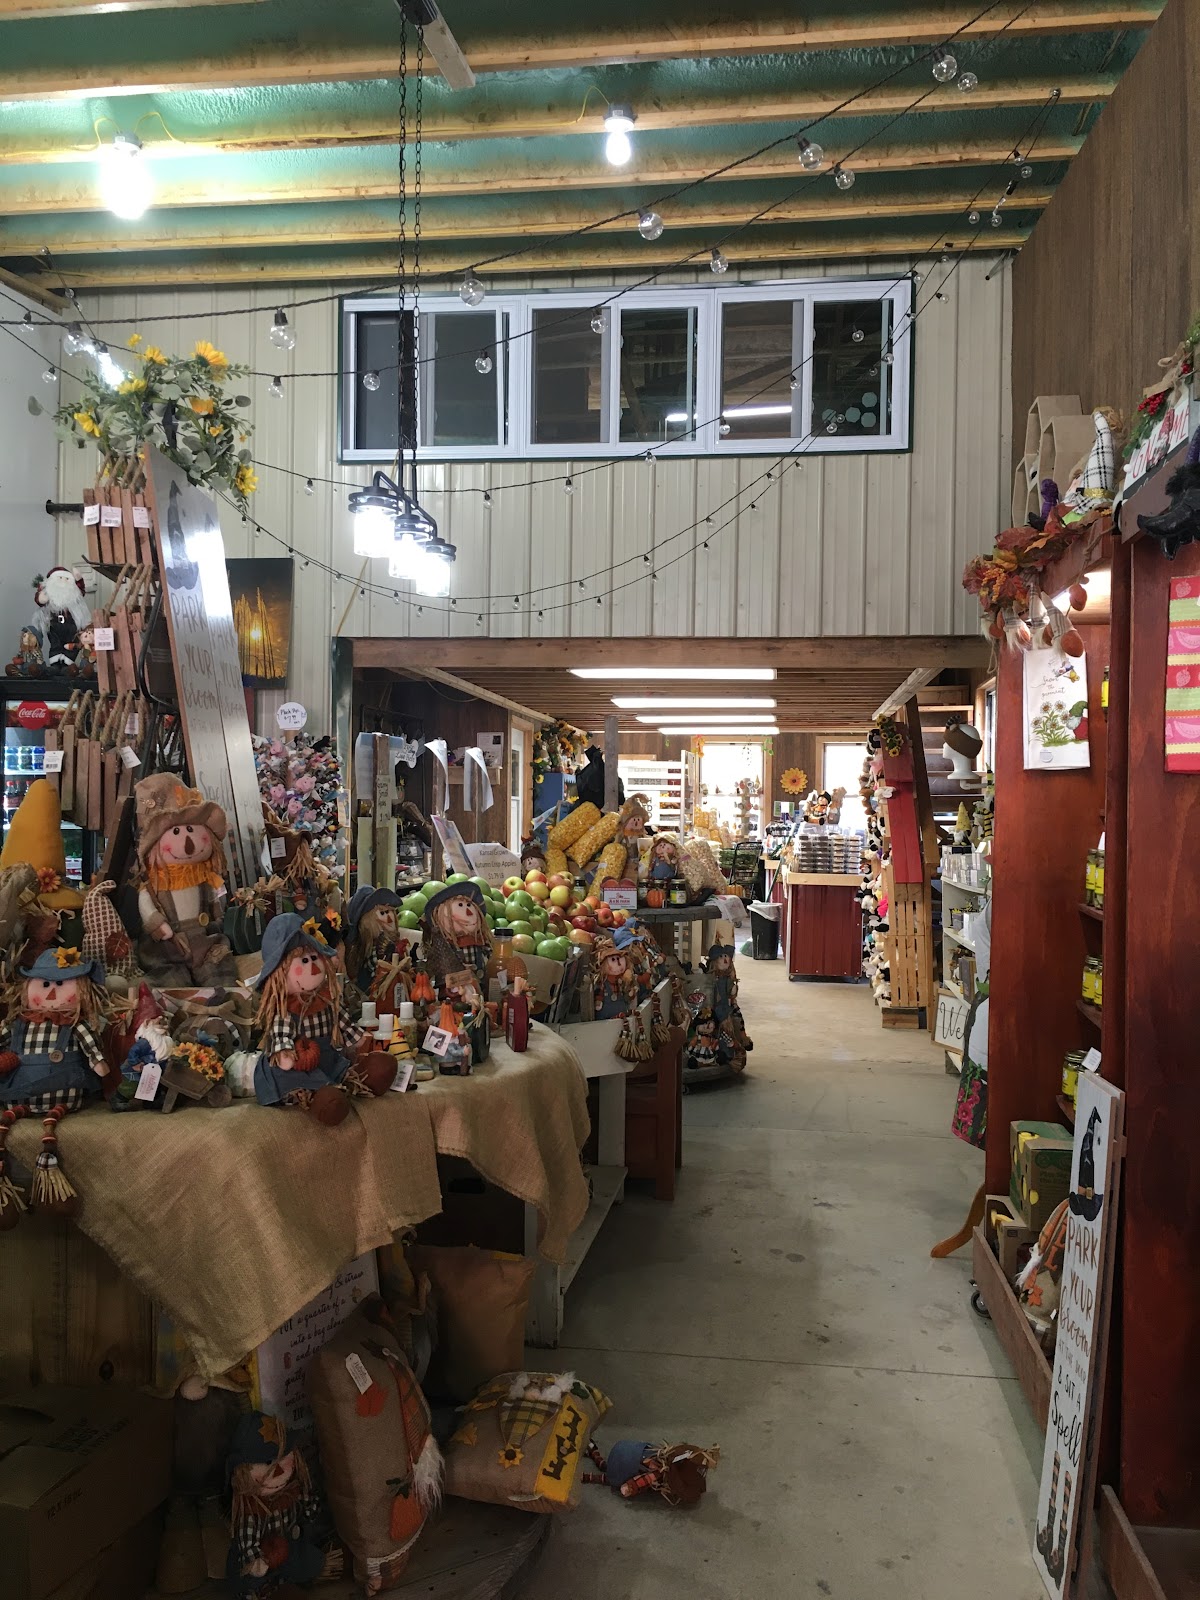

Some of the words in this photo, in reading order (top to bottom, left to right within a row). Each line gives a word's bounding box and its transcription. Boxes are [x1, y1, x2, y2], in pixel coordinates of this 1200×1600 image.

[170, 592, 208, 633] PARK
[184, 643, 213, 679] YOUR
[18, 707, 47, 719] Coca-Cola
[493, 848, 509, 856] Grown
[501, 860, 517, 868] Apples
[1067, 1216, 1099, 1270] PARK
[304, 1302, 331, 1328] quarter
[332, 1296, 340, 1316] of
[1070, 1270, 1094, 1322] YOUR
[290, 1332, 306, 1348] into
[313, 1324, 325, 1343] bag
[1064, 1373, 1076, 1401] SIT
[1076, 1393, 1081, 1413] A
[1051, 1390, 1082, 1468] Spell
